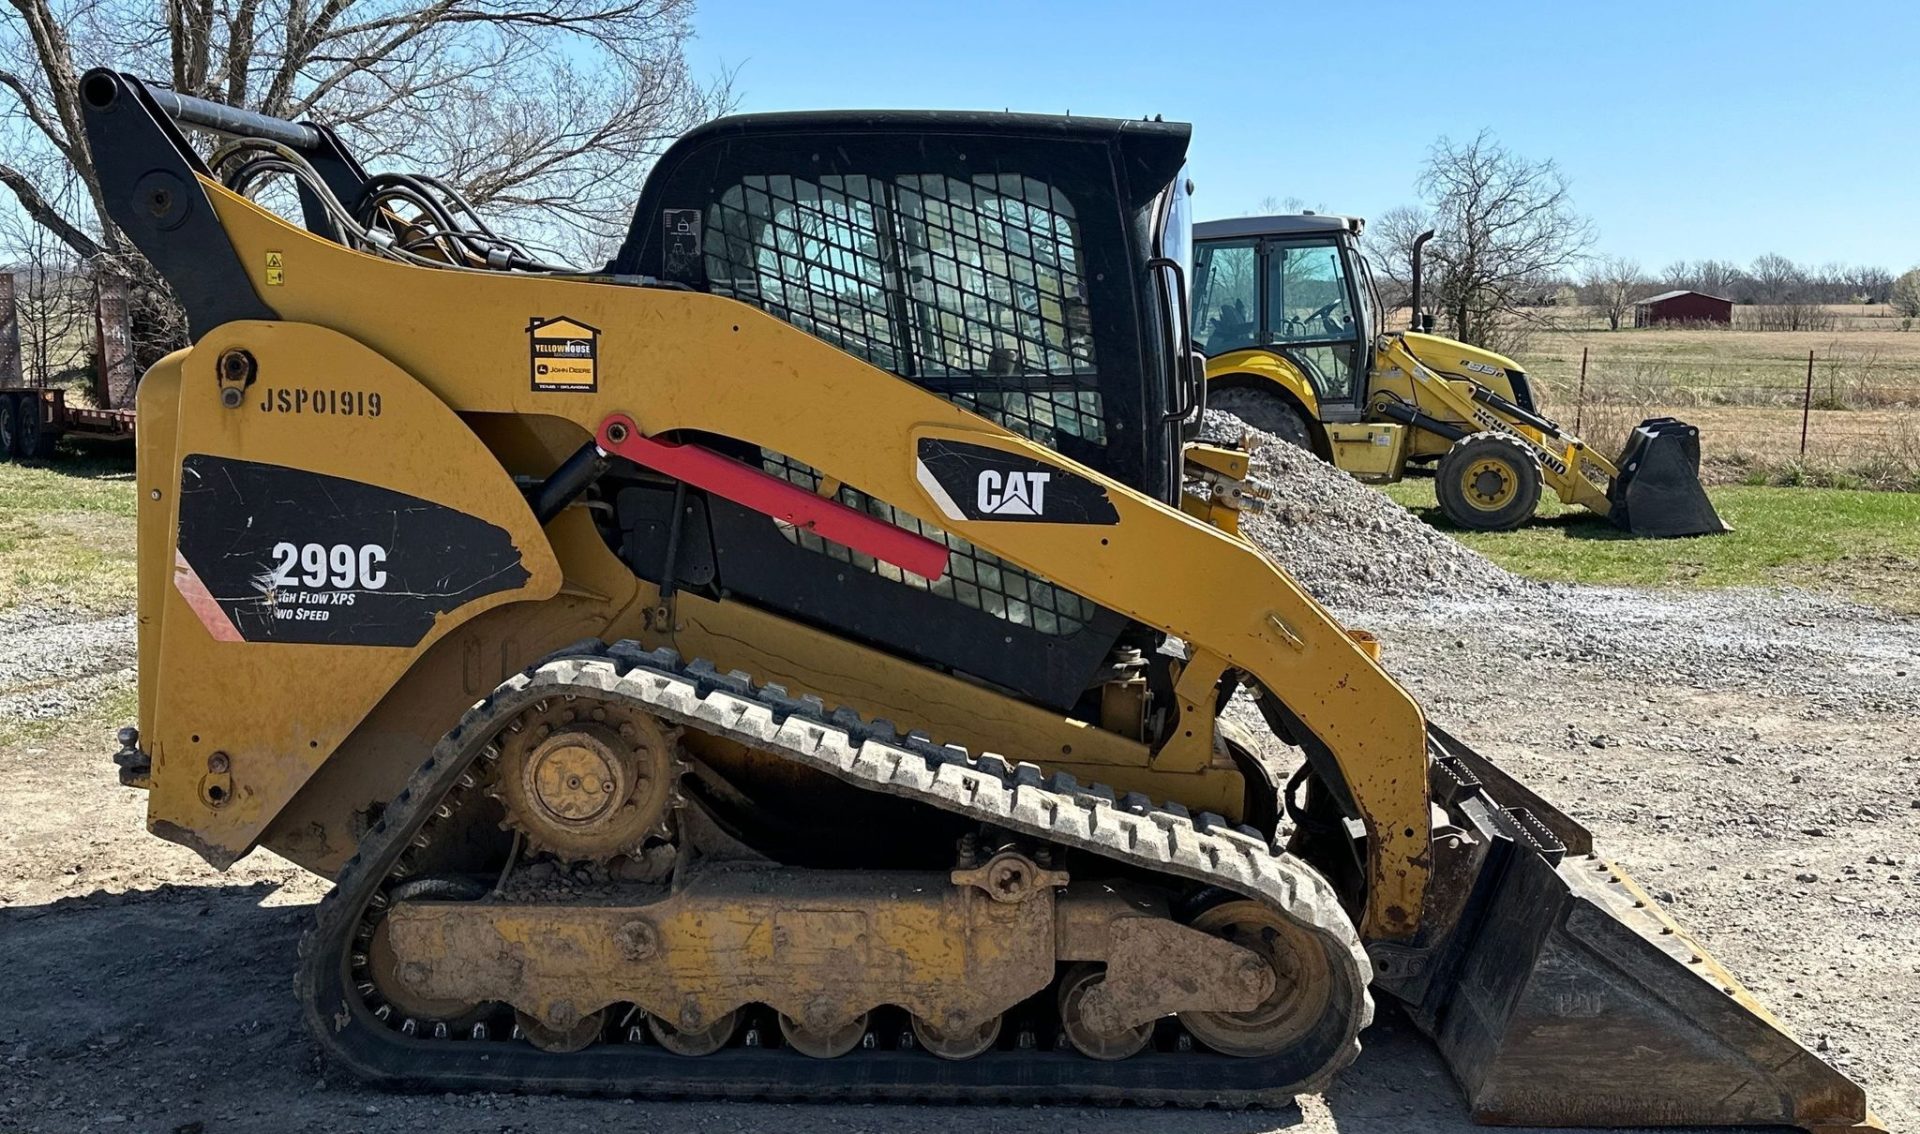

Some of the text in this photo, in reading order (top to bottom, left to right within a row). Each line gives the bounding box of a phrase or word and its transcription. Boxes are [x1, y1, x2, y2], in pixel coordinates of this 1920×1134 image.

[535, 340, 591, 353] YELLOWHOUSE
[260, 388, 382, 417] JSP01919
[1472, 408, 1506, 432] NEW
[977, 469, 1051, 515] CAT
[272, 542, 387, 590] 299C
[274, 592, 297, 603] IGH
[330, 593, 356, 606] XPS
[274, 607, 330, 621] WO SPEED
